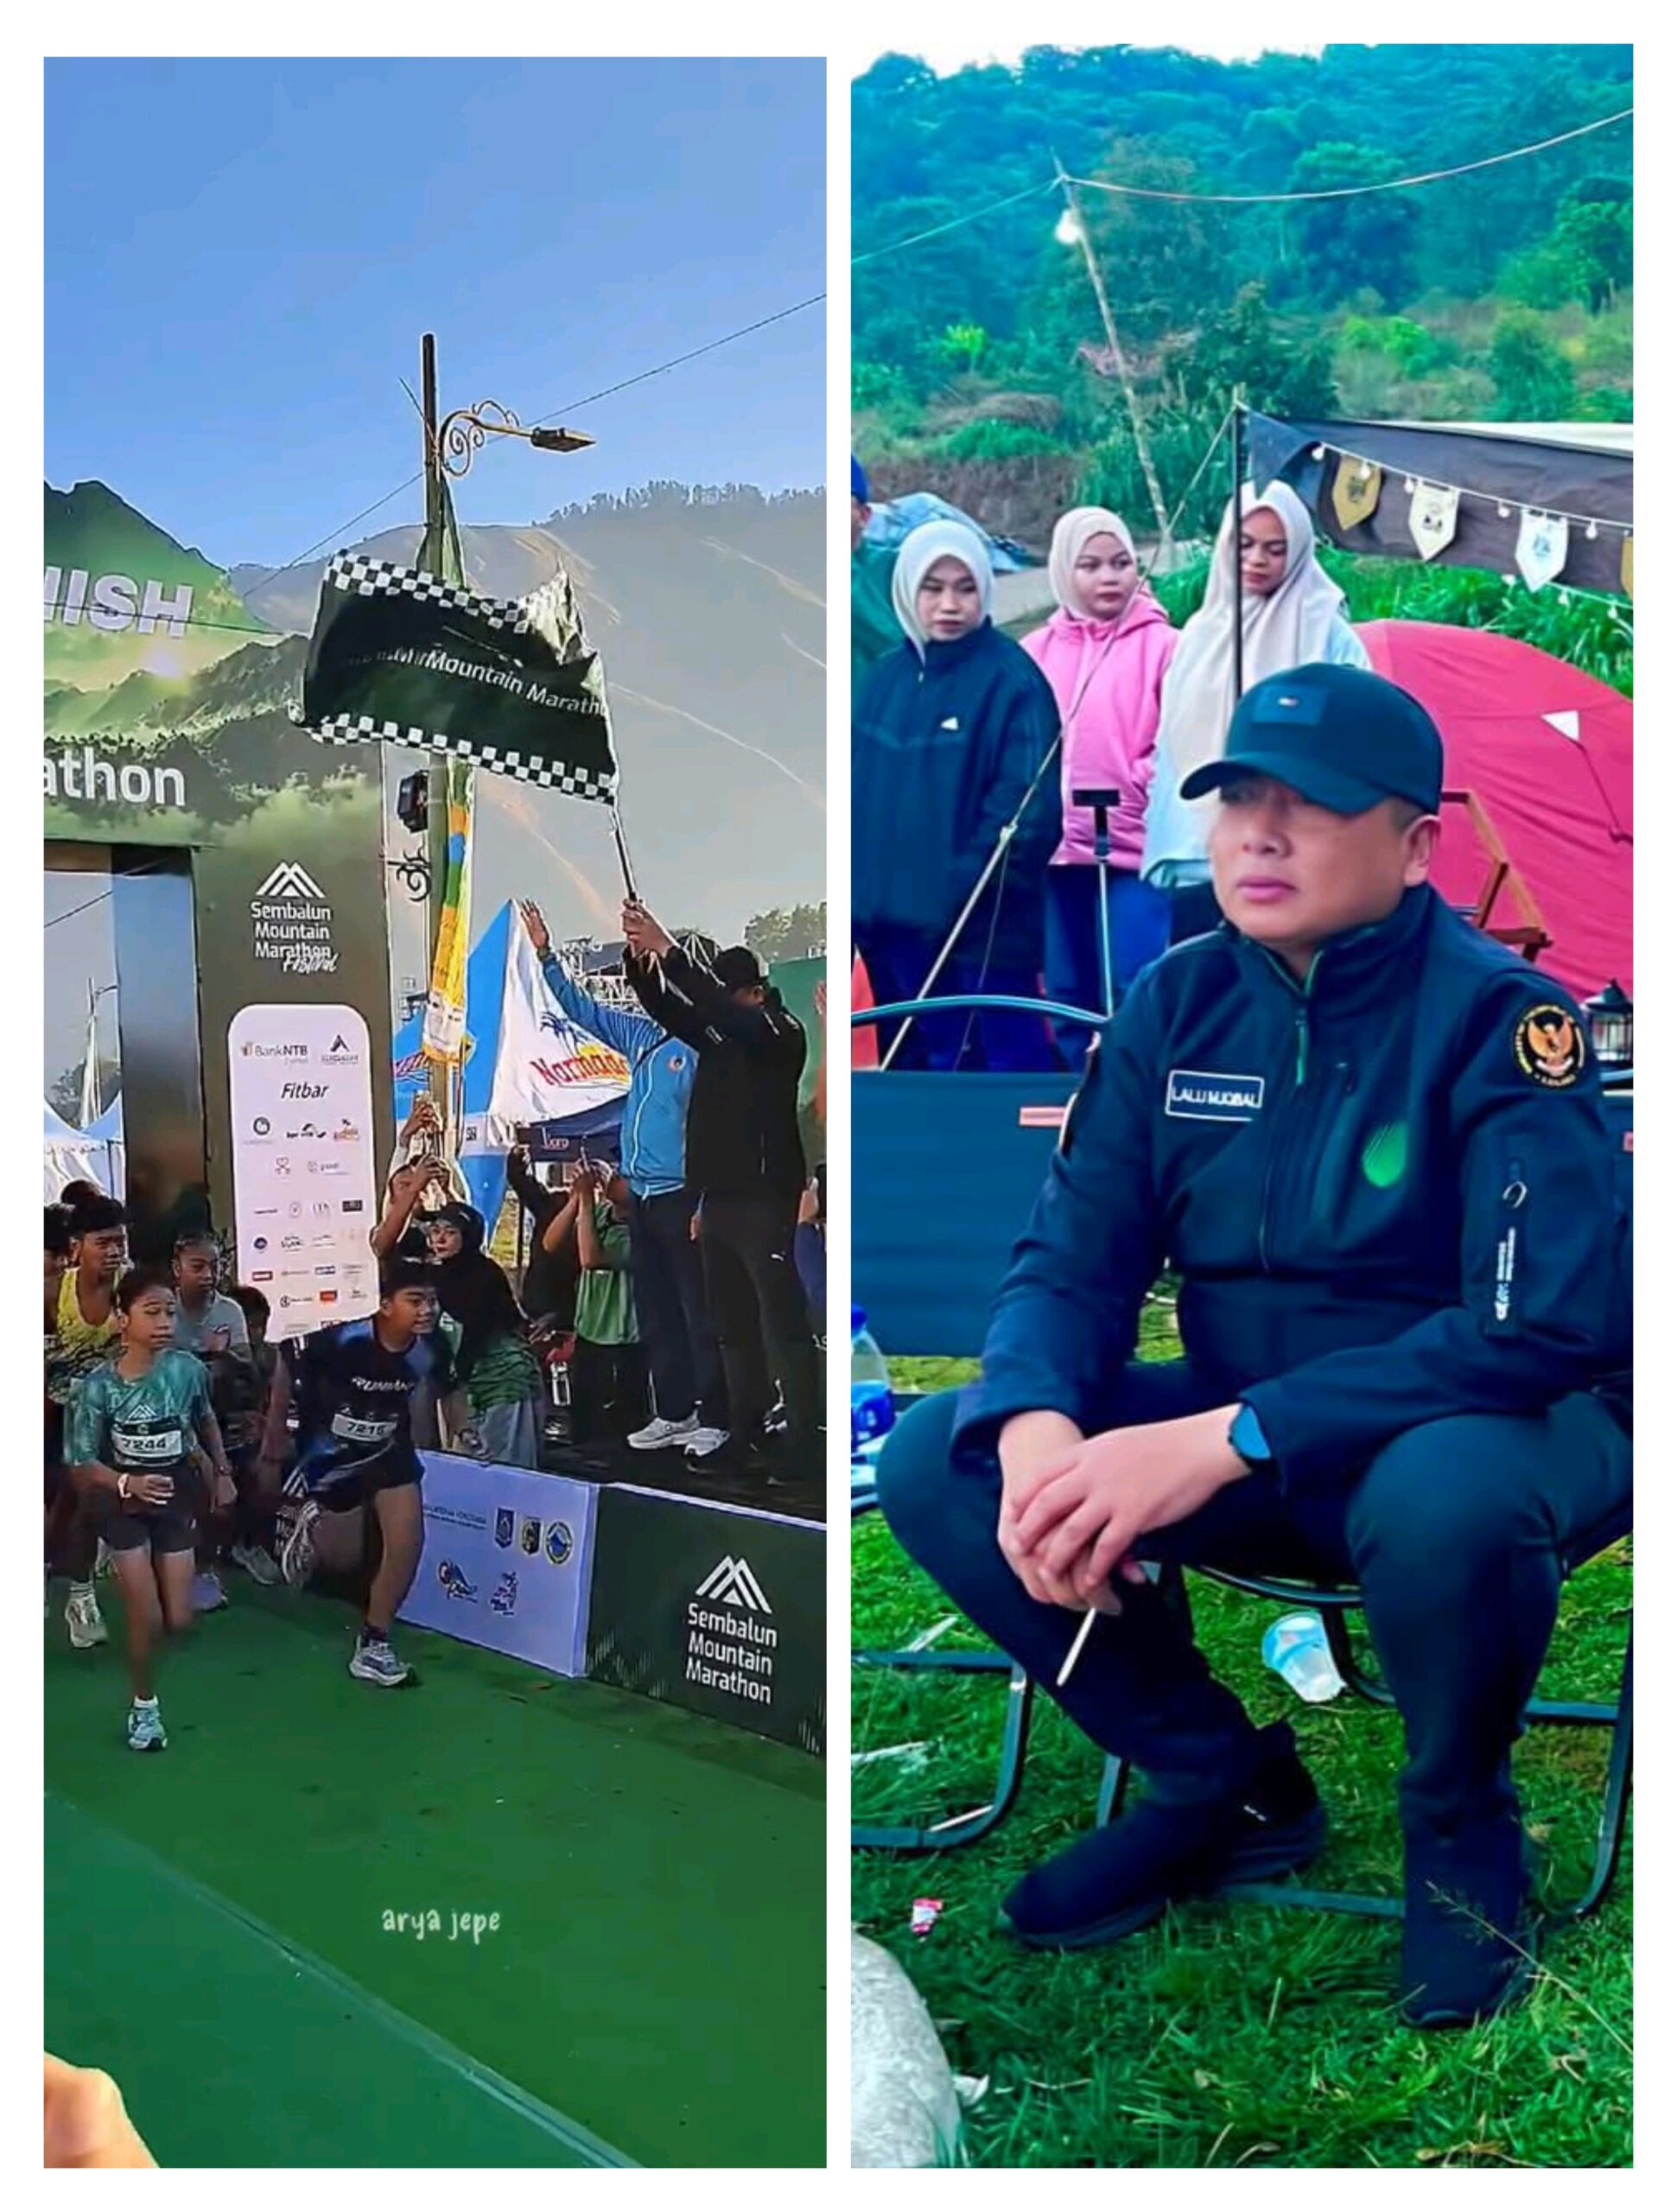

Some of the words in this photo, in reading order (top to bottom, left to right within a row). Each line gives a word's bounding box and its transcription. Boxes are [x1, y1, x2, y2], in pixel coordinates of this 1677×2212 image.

[424, 649, 524, 694] Mountain
[251, 901, 332, 920] Sembalun
[255, 921, 330, 939] Mountain
[255, 941, 332, 959] Marathon
[281, 1082, 330, 1099] Fitbar
[1172, 1086, 1206, 1103] LALU
[121, 1437, 166, 1450] 7244
[688, 1602, 778, 1648] Sembalun
[688, 1630, 773, 1675] Mountain
[685, 1656, 772, 1705] Marathon
